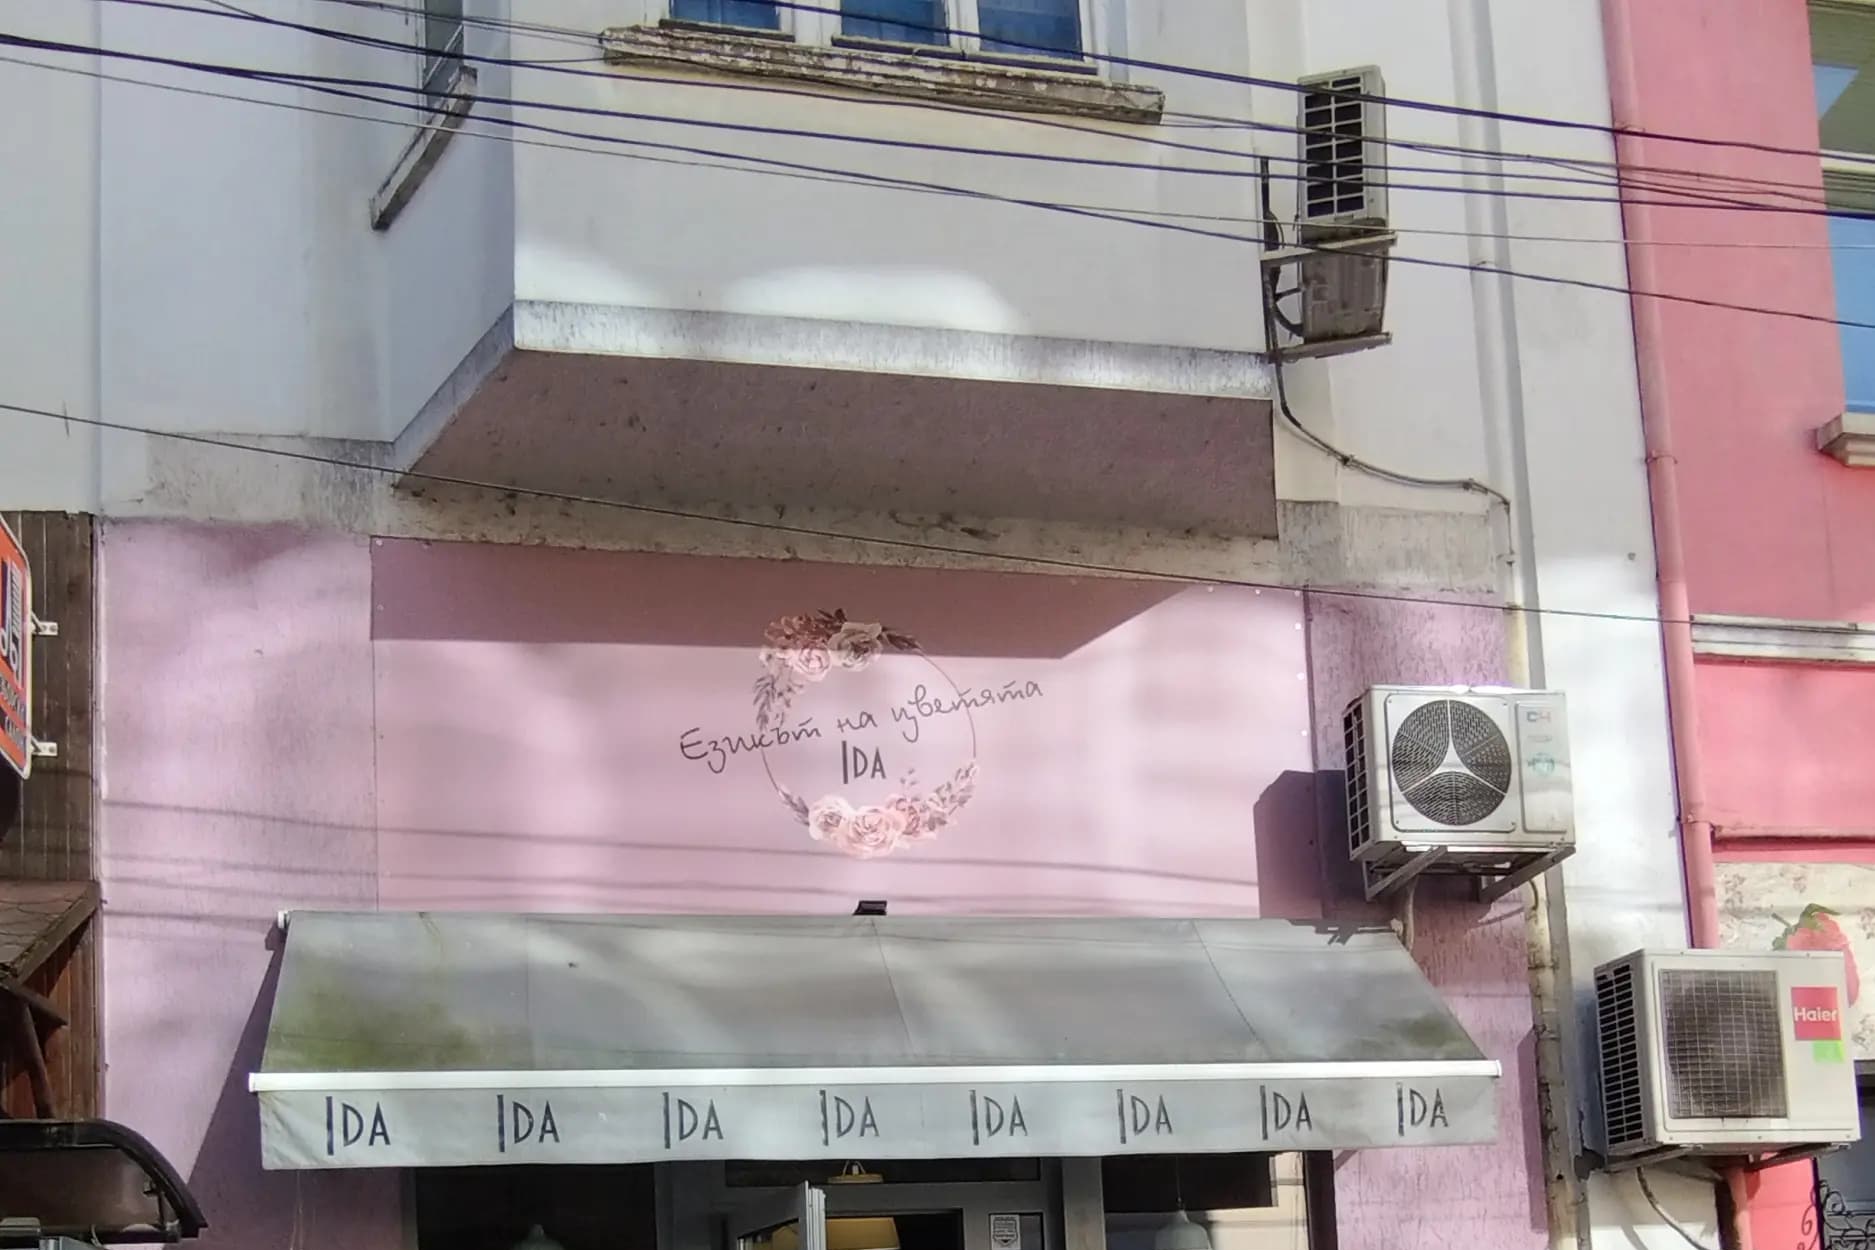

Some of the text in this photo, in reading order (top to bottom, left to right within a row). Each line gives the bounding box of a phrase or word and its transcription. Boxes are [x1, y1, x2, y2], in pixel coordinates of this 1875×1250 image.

[837, 710, 878, 732] на
[891, 680, 1044, 743] цветята
[841, 741, 887, 784] IDA
[1794, 1007, 1838, 1022] Haier
[325, 1082, 1449, 1156] IDA IDA IDA IDA IDA IDA IDA IDA
